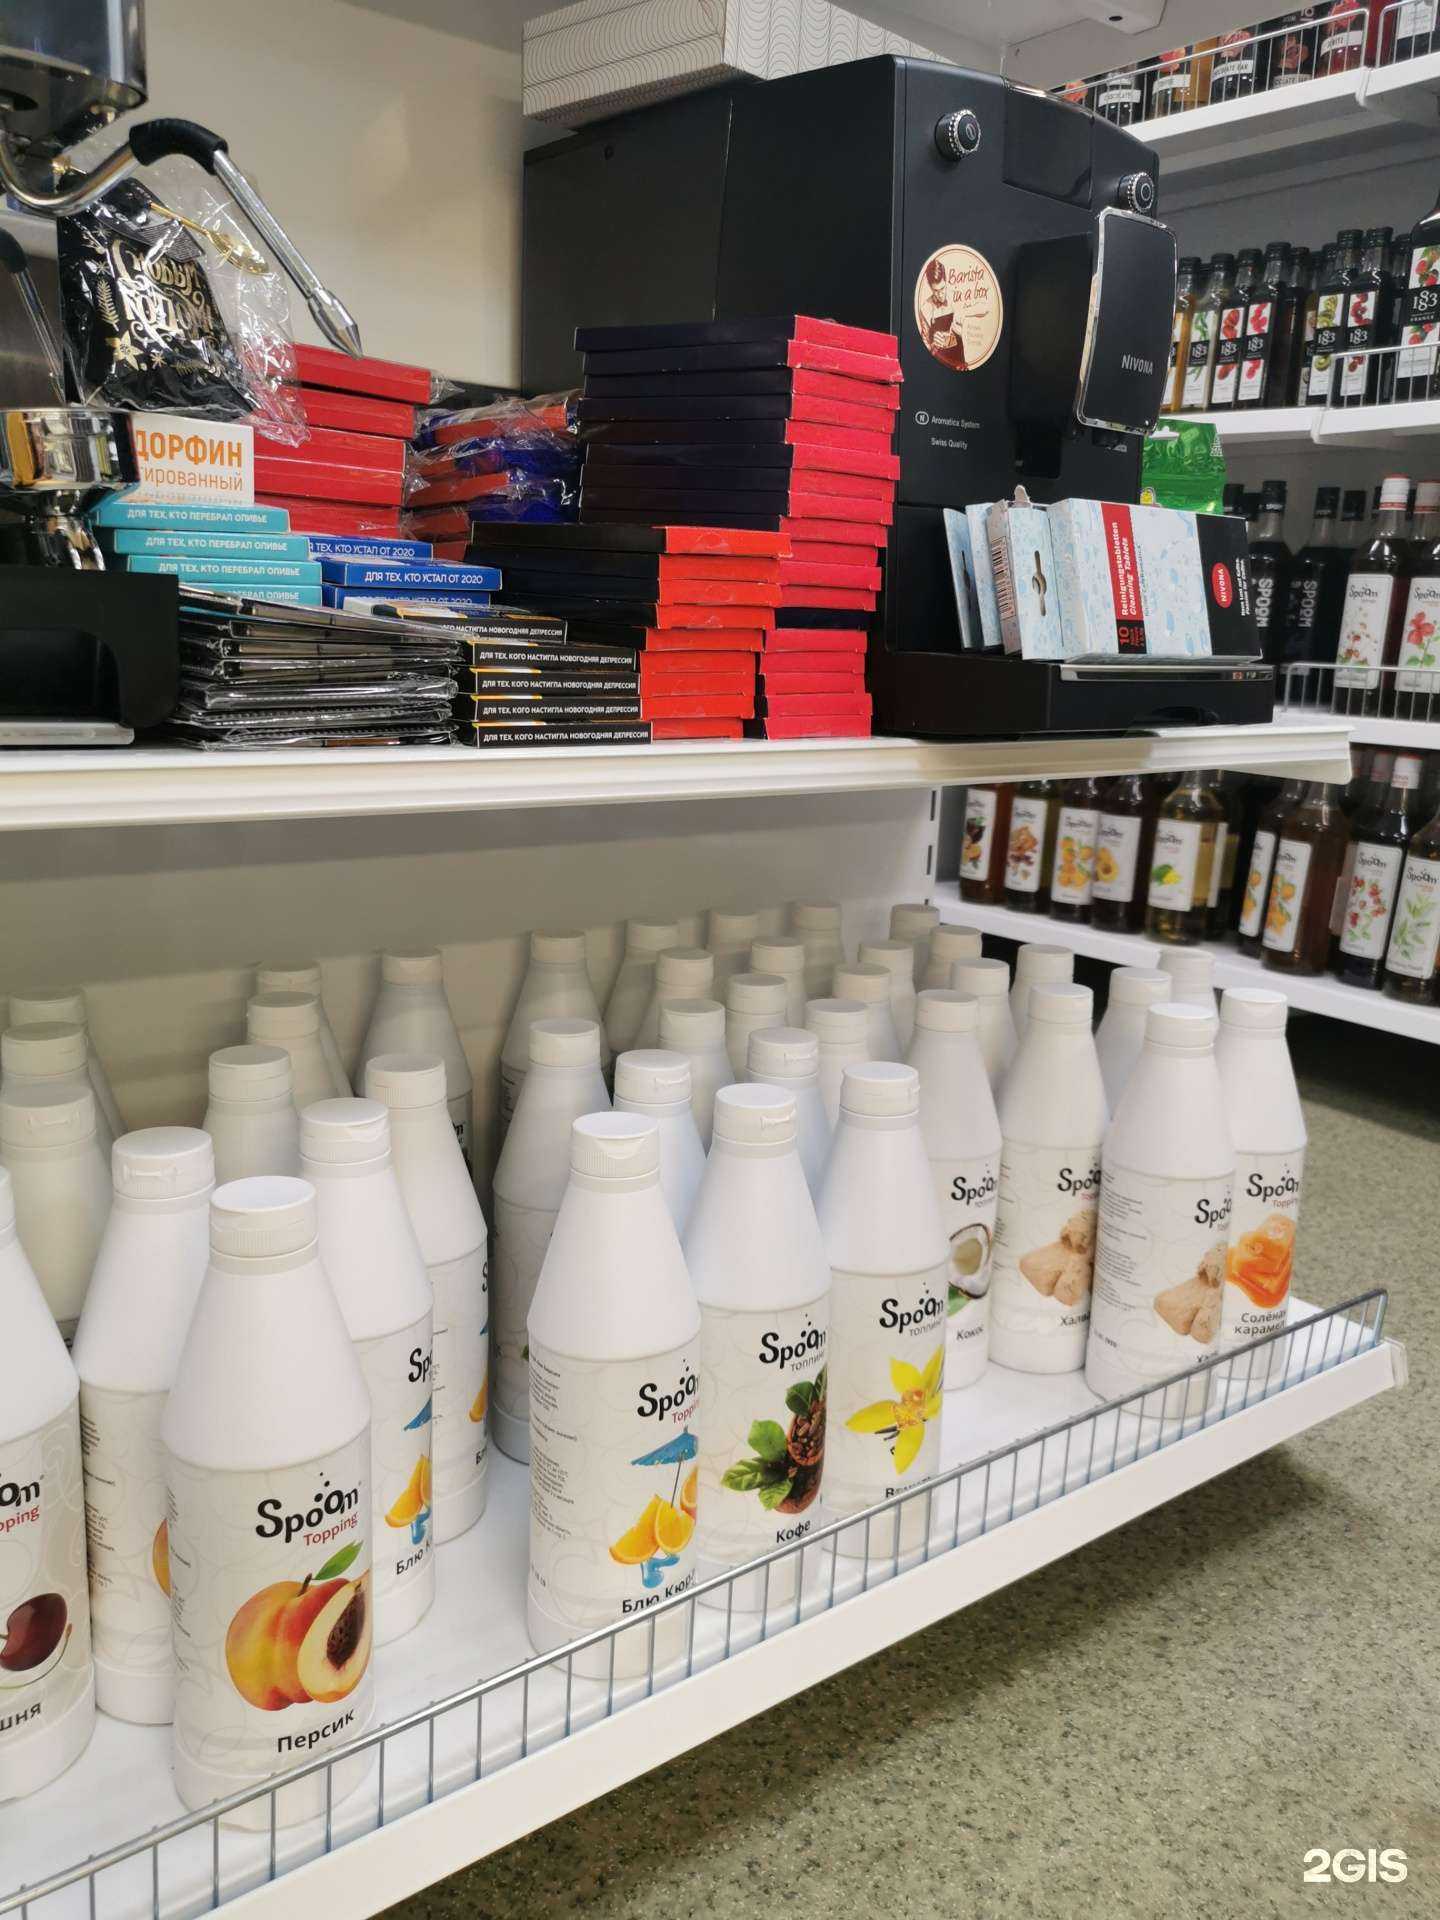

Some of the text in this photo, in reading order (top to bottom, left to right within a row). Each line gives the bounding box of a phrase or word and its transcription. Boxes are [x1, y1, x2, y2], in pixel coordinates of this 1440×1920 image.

[948, 265, 984, 285] Barista
[953, 281, 988, 302] in a box
[1122, 354, 1154, 375] NIVONA
[931, 437, 968, 450] Swiss Quality
[144, 467, 243, 492] ированный
[128, 510, 146, 519] ДЛЯ
[170, 511, 187, 520] КТО
[190, 512, 232, 521] ПЕРЕБРАЛ
[146, 536, 166, 546] ДЛЯ
[188, 538, 206, 548] КТО
[208, 540, 252, 550] ПЕРЕБРАЛ
[335, 544, 352, 553] КТО
[353, 544, 378, 554] УСТАЛ
[380, 546, 390, 556] ОТ
[392, 548, 415, 556] 2020
[158, 562, 178, 572] ДЛЯ
[201, 564, 220, 574] КТО
[222, 564, 266, 574] ПЕРЕБРАЛ
[364, 571, 384, 582] ДЛЯ
[404, 573, 421, 583] КТО
[422, 574, 448, 584] УСТАЛ
[448, 574, 460, 584] ОТ
[461, 575, 483, 584] 2020
[1111, 522, 1130, 616] Reinigungstabletten
[1125, 574, 1138, 616] Cleaning
[1218, 568, 1228, 602] NIVONA
[1256, 578, 1274, 628] SPOOM
[1118, 626, 1130, 646] 10
[480, 651, 494, 660] ДЛЯ
[509, 652, 526, 660] КОГО
[528, 653, 558, 662] НАСТИГЛА
[560, 654, 600, 664] НОВОГОДНЯЯ
[600, 656, 632, 665] ДЕПРЕССИЯ
[482, 680, 496, 688] ДЛЯ
[512, 680, 528, 688] КОГО
[530, 680, 562, 689] НАСТИГЛА
[564, 681, 603, 690] НОВОГОДНЯЯ
[604, 681, 636, 690] ДЕПРЕССИЯ
[483, 706, 496, 715] ДЛЯ
[512, 706, 530, 714] КОГО
[531, 706, 563, 714] НАСТИГЛА
[564, 706, 604, 714] НОВОГОДНЯЯ
[606, 706, 638, 714] ДЕПРЕССИЯ
[484, 733, 498, 742] ДЛЯ
[514, 732, 532, 741] КОГО
[534, 732, 568, 740] НАСТИГЛА
[570, 732, 613, 740] НОВОГОДНЯЯ
[614, 730, 649, 740] ДЕПРЕССИЯ
[303, 1512, 359, 1546] Topping
[776, 1520, 811, 1544] Кофе
[396, 1548, 424, 1576] Блю
[0, 1702, 42, 1732] шня
[276, 1708, 356, 1752] Персик
